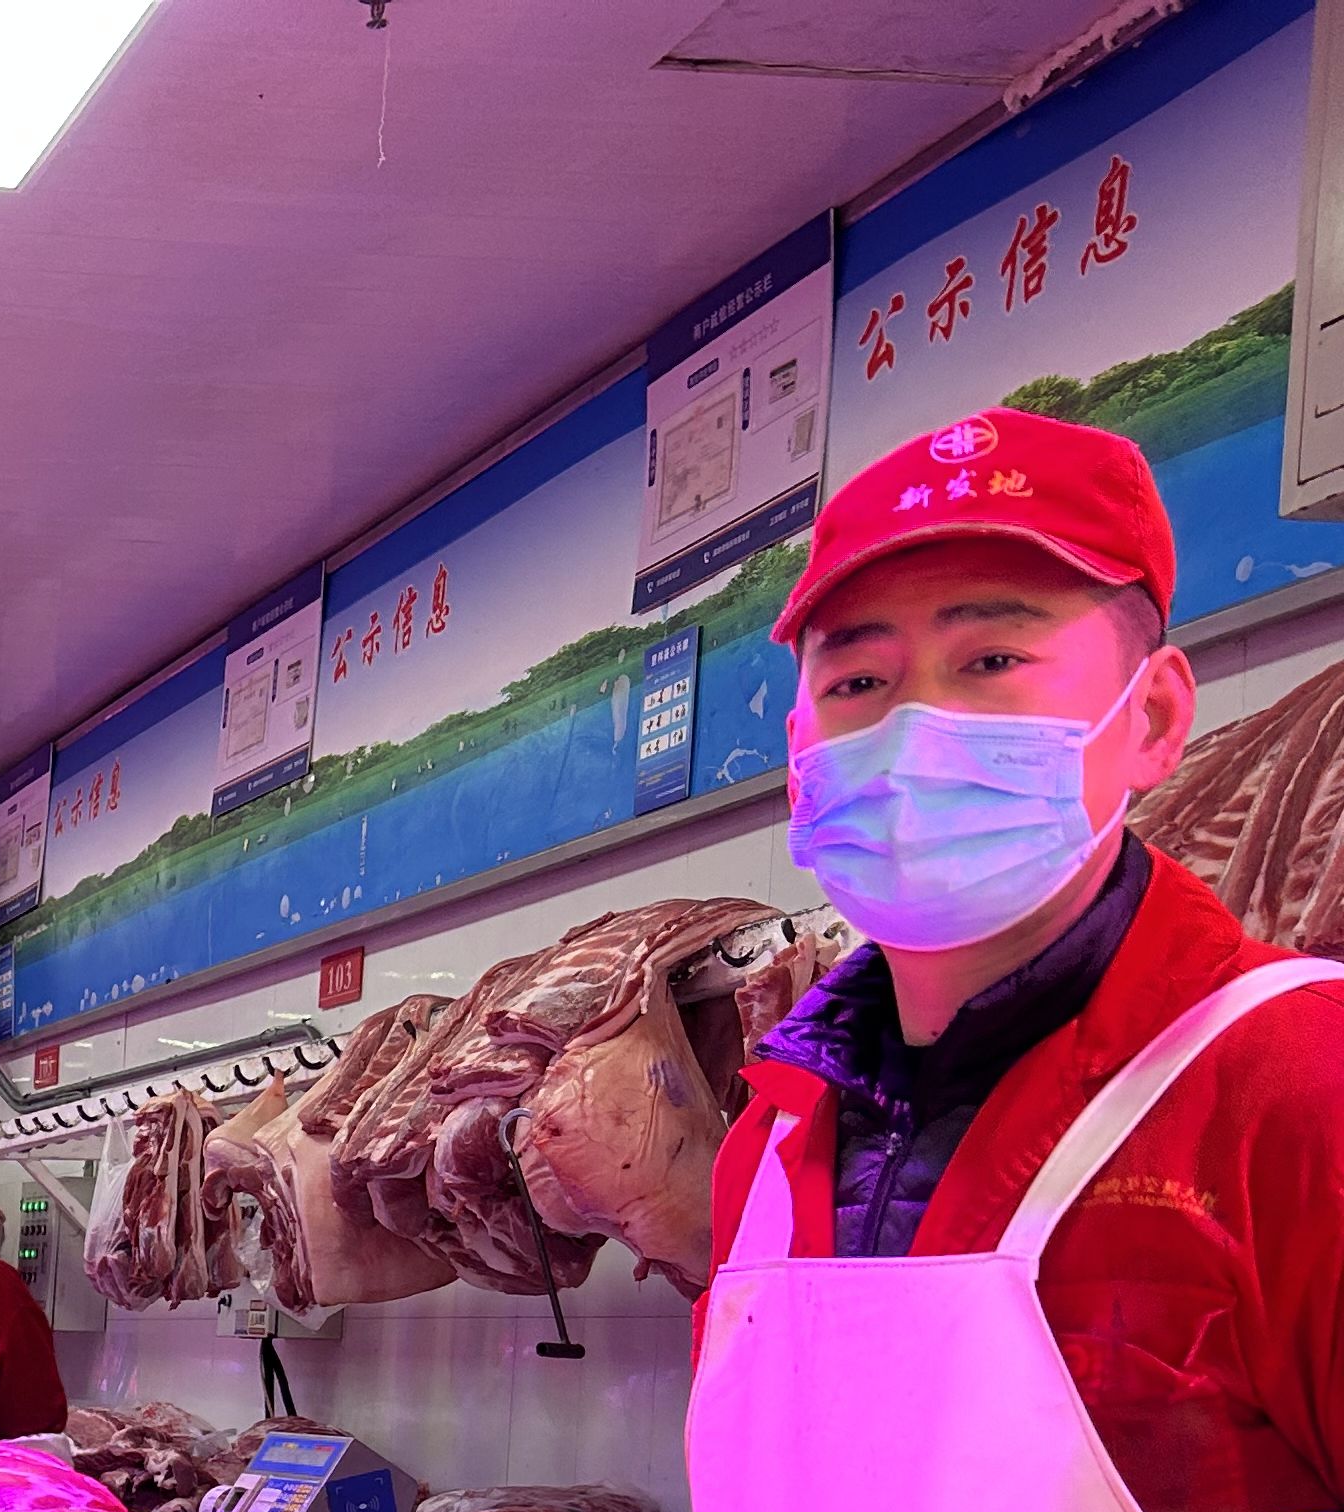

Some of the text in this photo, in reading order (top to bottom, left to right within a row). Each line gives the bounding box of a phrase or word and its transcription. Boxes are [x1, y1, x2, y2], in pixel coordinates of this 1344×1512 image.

[858, 156, 1138, 371] 公示信息
[891, 467, 1034, 512] 新发地
[330, 562, 450, 683] 公示信息
[53, 756, 121, 837] 公示信息
[327, 961, 353, 995] 103
